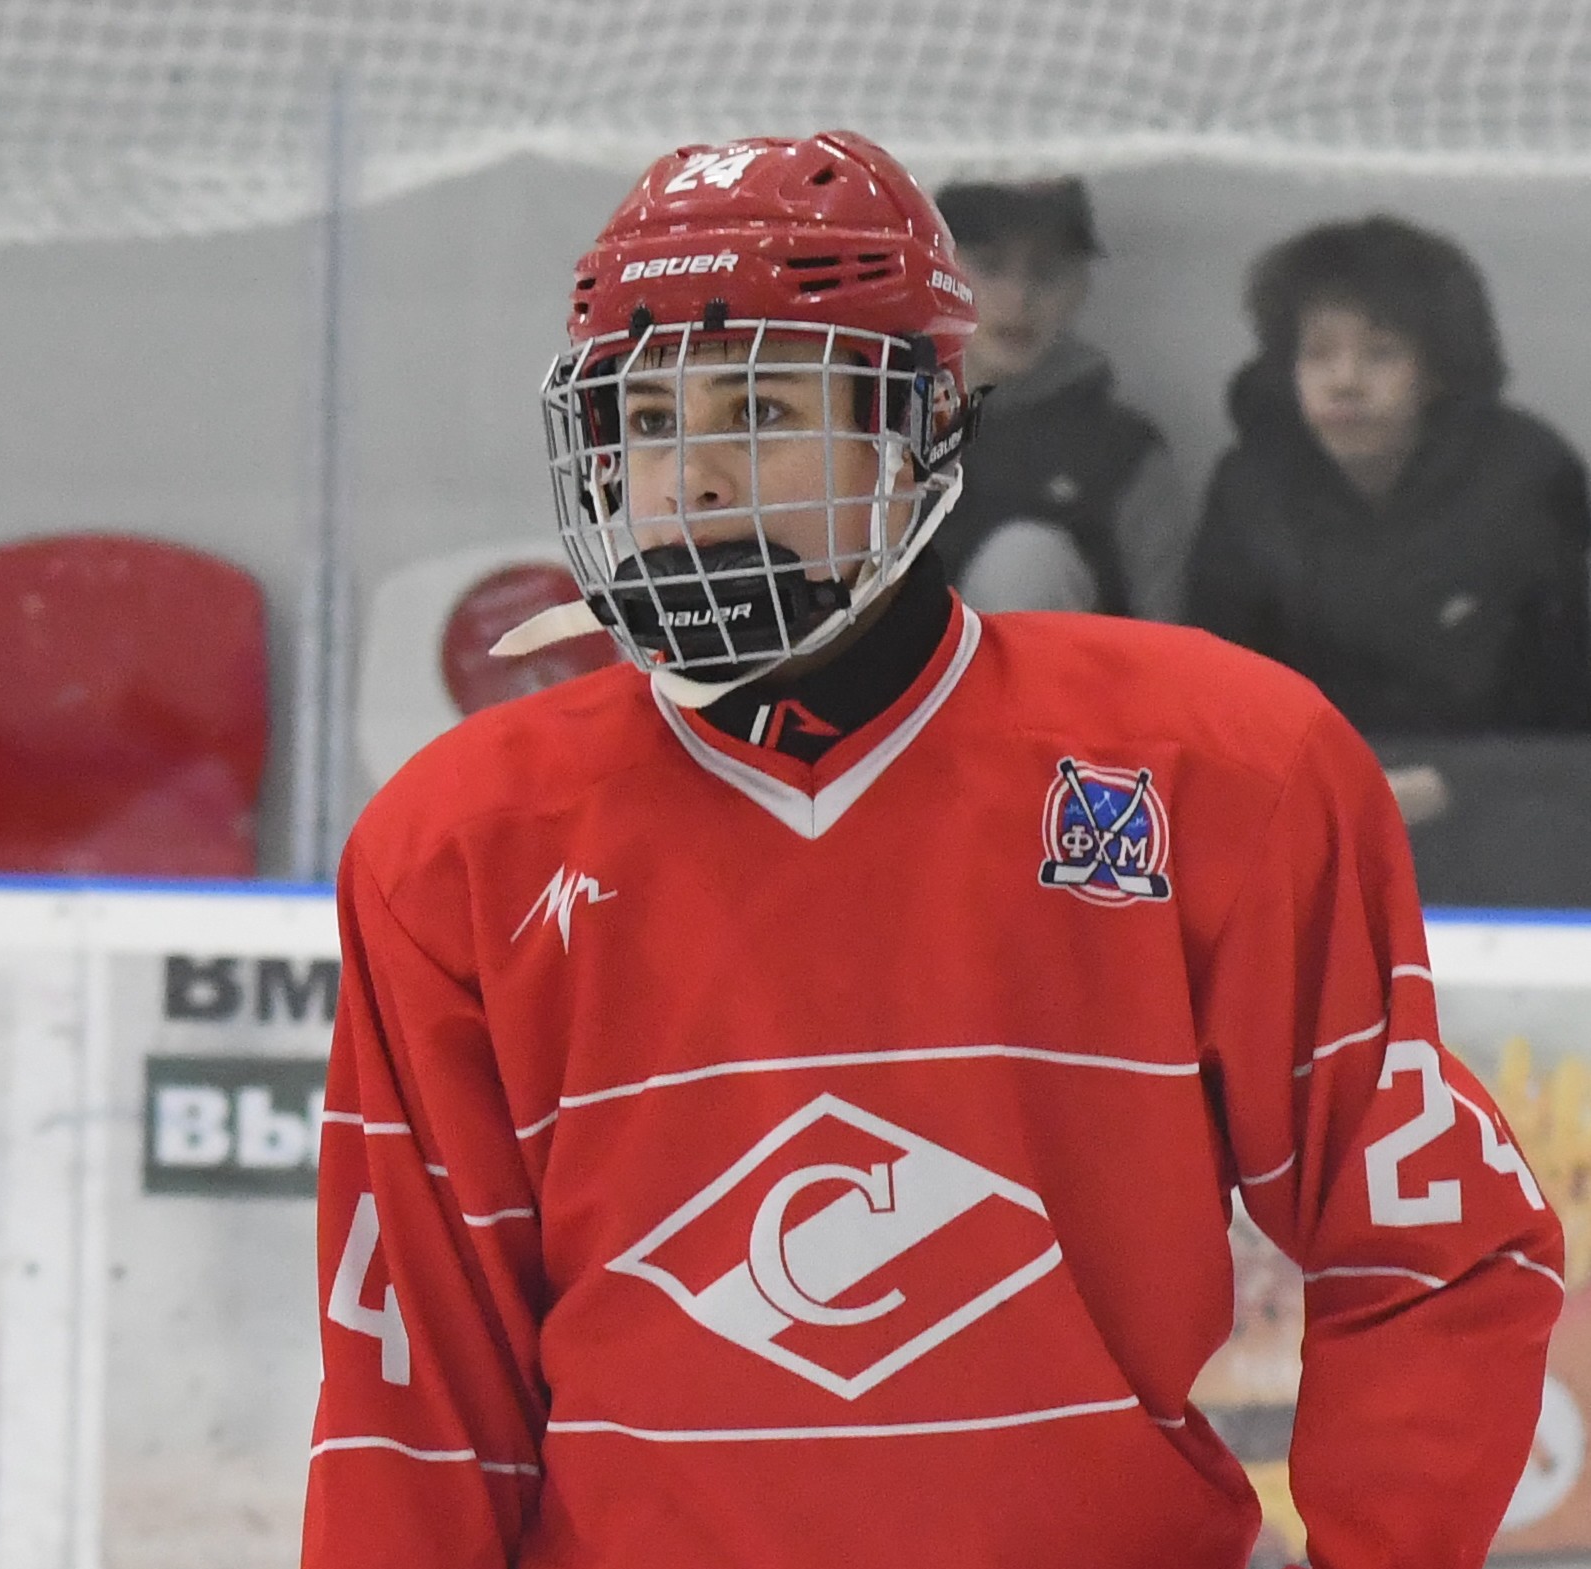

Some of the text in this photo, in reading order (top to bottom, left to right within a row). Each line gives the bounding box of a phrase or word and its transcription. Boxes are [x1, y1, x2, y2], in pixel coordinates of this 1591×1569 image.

[664, 153, 756, 194] 24
[620, 253, 739, 283] BAUER
[1061, 825, 1148, 869] ФХМ
